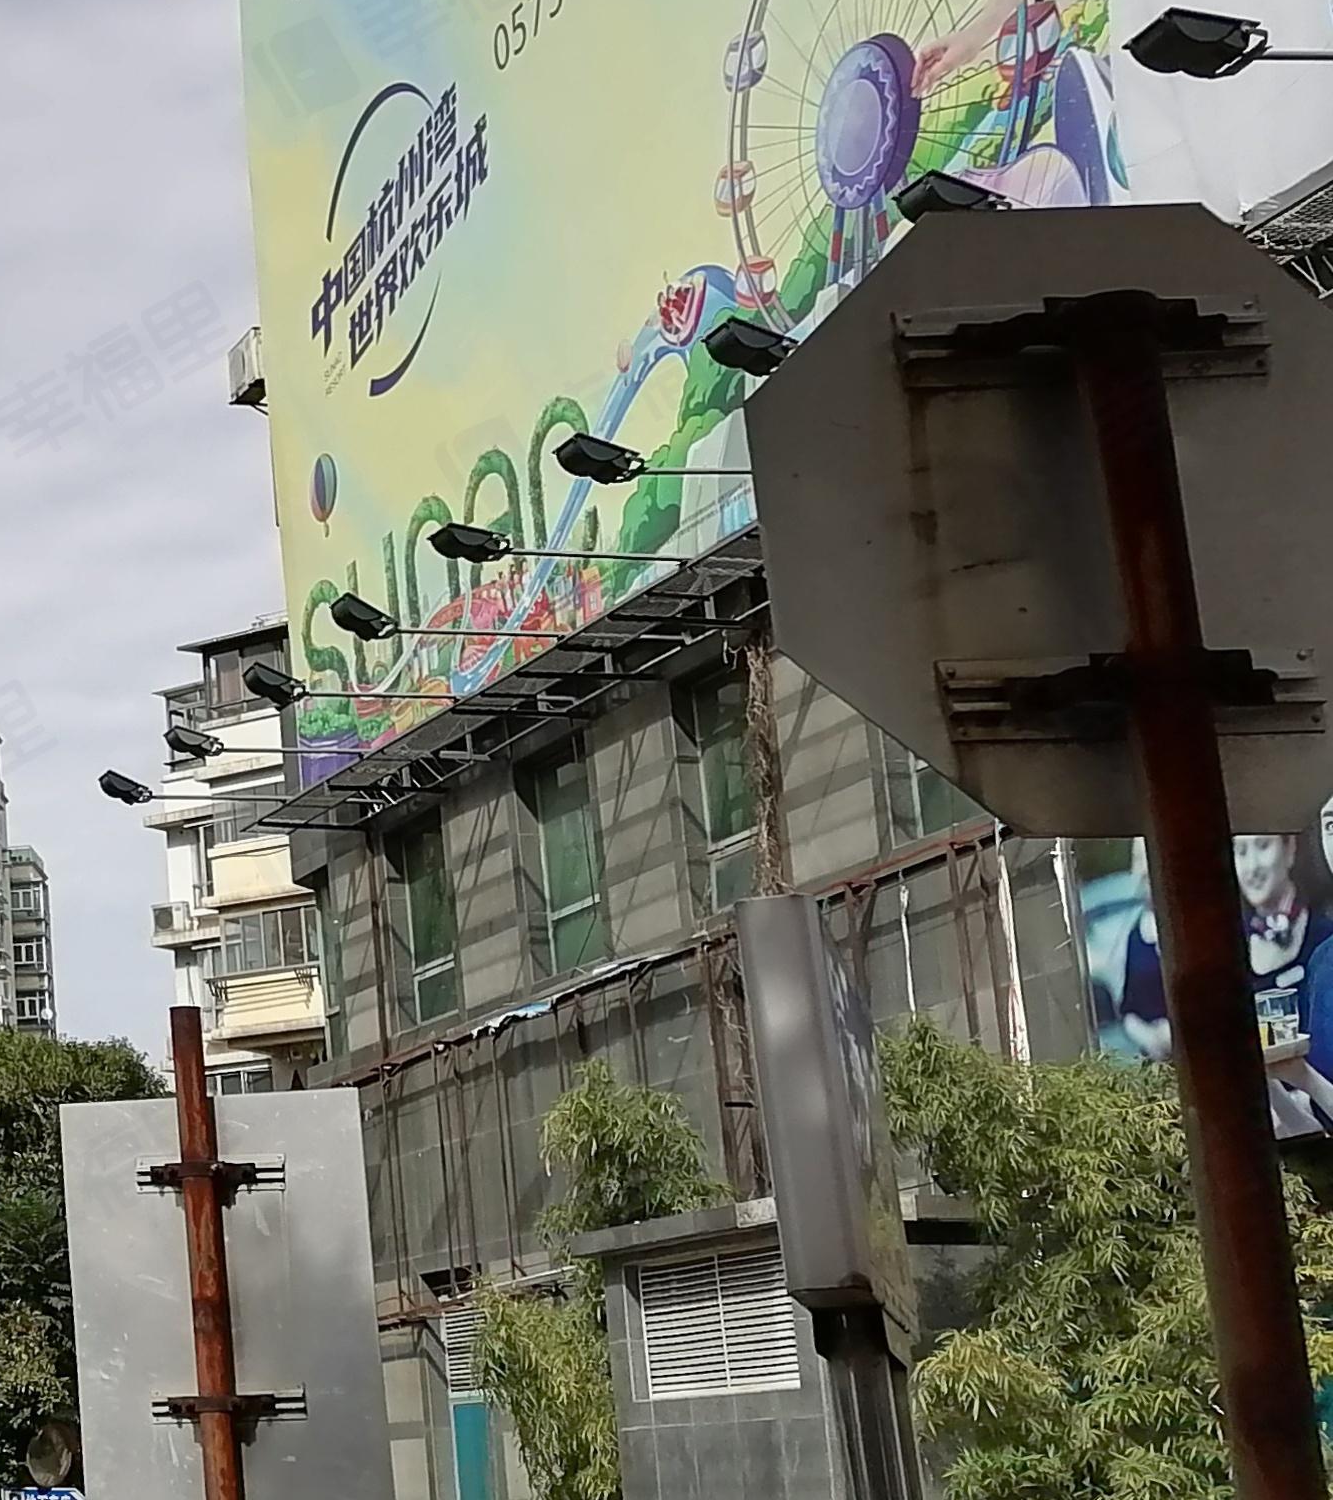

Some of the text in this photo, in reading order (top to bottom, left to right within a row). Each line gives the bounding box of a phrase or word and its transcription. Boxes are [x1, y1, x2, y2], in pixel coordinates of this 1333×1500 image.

[310, 81, 457, 359] 中国杭州湾
[348, 111, 489, 371] 世界欢乐城
